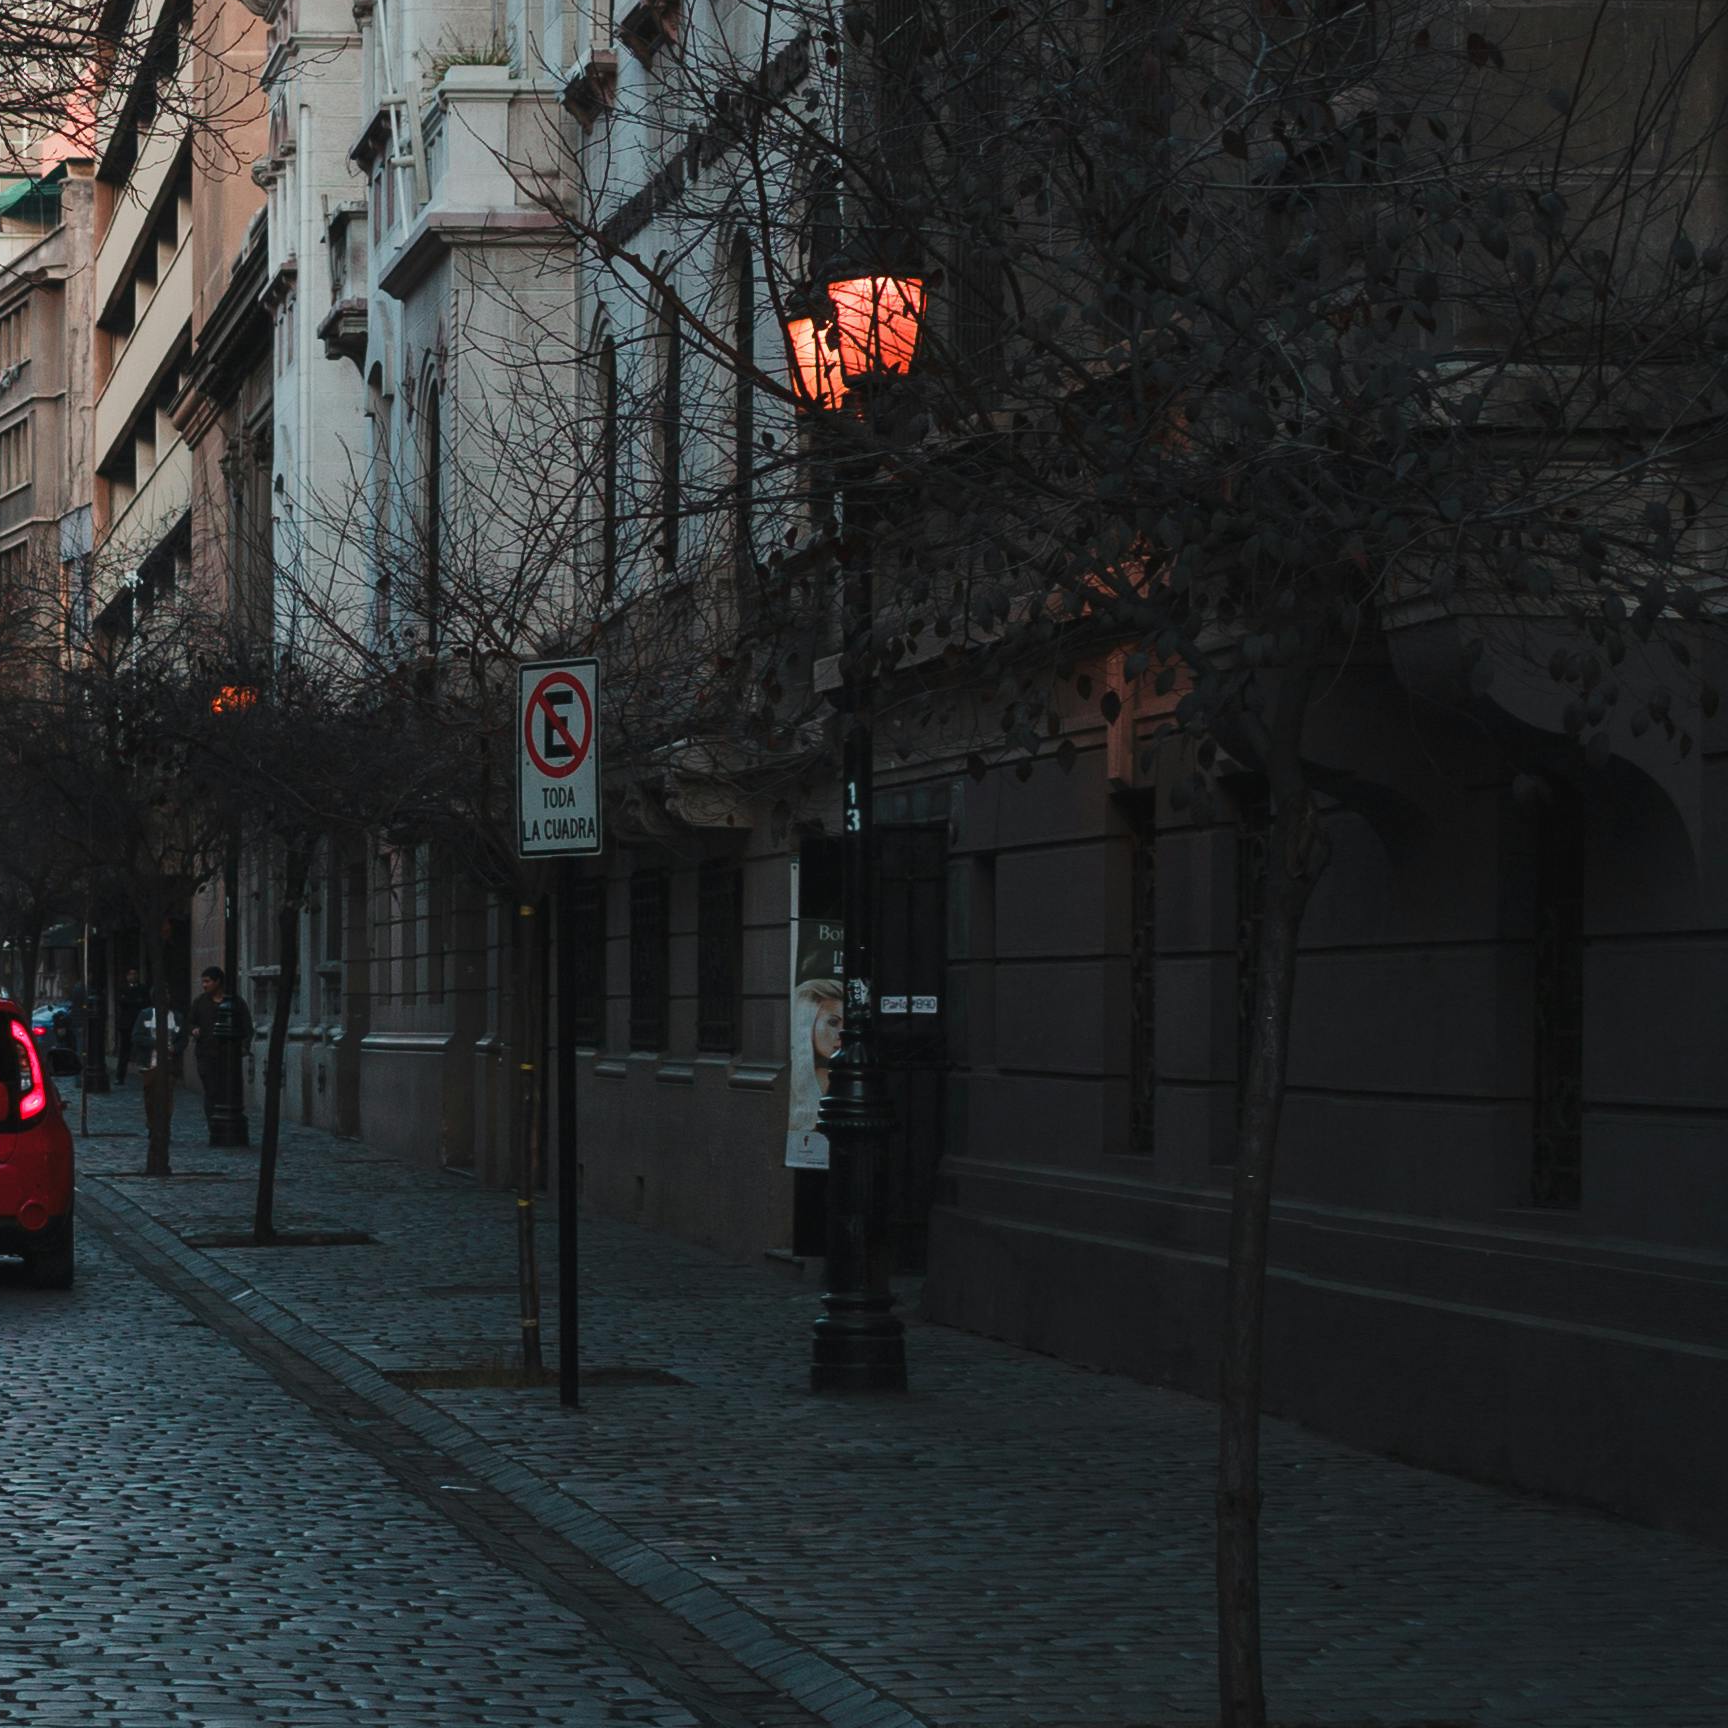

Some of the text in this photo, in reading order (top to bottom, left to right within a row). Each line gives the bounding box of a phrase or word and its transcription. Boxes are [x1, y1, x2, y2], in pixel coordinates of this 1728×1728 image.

[542, 786, 576, 809] TODA
[846, 781, 861, 831] 13
[523, 817, 595, 842] LA CUADRA
